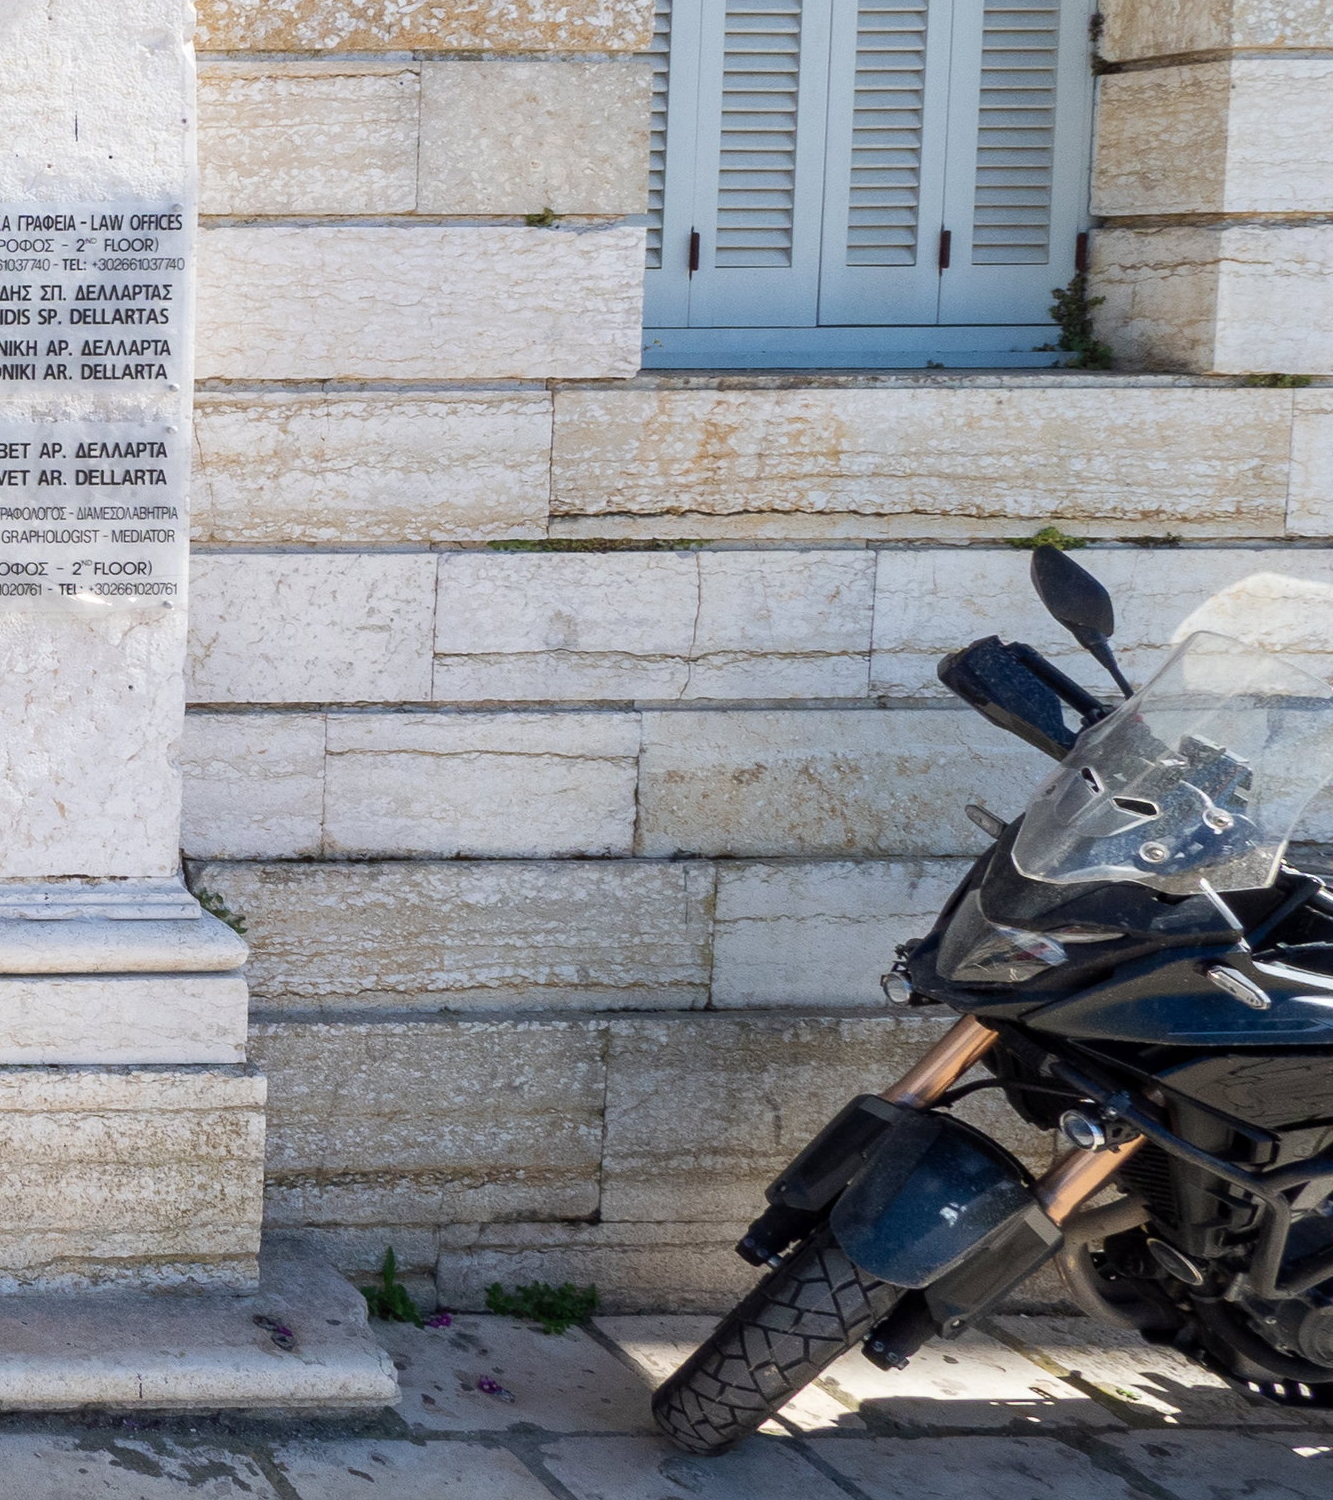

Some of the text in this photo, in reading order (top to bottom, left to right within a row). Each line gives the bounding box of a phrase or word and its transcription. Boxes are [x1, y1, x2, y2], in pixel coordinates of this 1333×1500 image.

[18, 214, 76, 232] ΓΡΑΦΕΙΑ
[90, 214, 124, 231] LAW
[129, 213, 183, 231] OFFICES
[104, 237, 160, 254] FLOOR)
[62, 258, 87, 271] TEL:
[92, 257, 186, 271] +302661037740
[40, 285, 67, 301] ΣΠ.
[74, 284, 173, 301] ΔΕΛΛΑΡΤΑΣ
[37, 309, 63, 325] SP.
[69, 308, 170, 325] DELLARTAS
[45, 340, 73, 356] ΑΡ.
[81, 339, 172, 356] ΔΕΛΛΑΡΤΑ
[43, 364, 73, 380] AR.
[81, 363, 168, 380] DELLARTA
[38, 443, 67, 459] ΑΡ.
[75, 442, 168, 459] ΔΕΛΛΑΡΤΑ
[37, 469, 68, 486] AR.
[75, 468, 168, 486] DELLARTA
[76, 506, 179, 520] ΔΙΑΜΕΣΟΛΑΒΗΤΡΙΑ
[1, 529, 100, 544] GRAPHOLOGIST
[111, 529, 176, 543] MEDIATOR
[94, 560, 153, 577] FLOOR)
[89, 582, 178, 596] +302661020761
